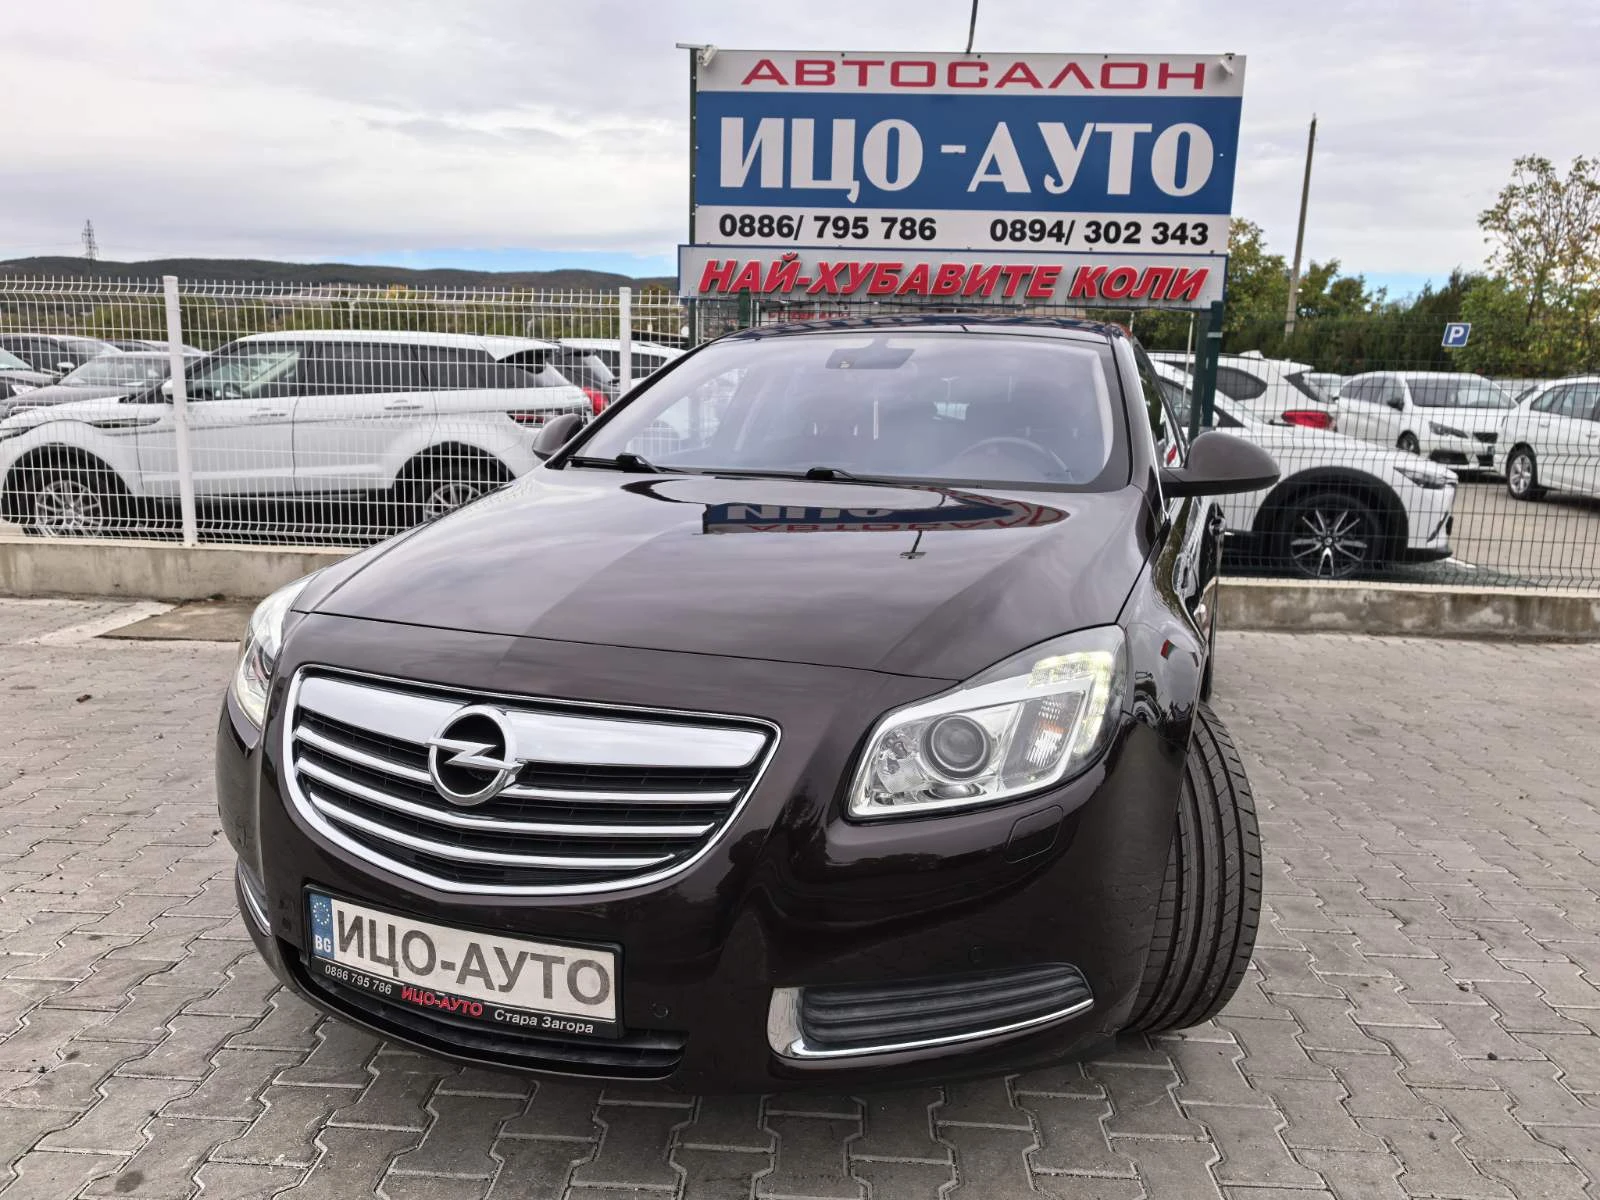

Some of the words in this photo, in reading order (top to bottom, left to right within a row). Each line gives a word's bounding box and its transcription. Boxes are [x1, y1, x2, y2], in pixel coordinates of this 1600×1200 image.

[741, 59, 1206, 90] АВТОСАЛОН
[718, 213, 805, 241] 0886/
[813, 215, 870, 240] 795
[880, 216, 938, 241] 786
[989, 219, 1076, 246] 0894/
[1083, 220, 1142, 245] 302
[1151, 222, 1210, 246] 343
[698, 251, 1063, 298] НАЙ-ХУБАВИТЕ
[1066, 265, 1209, 301] КОЛИ
[1448, 326, 1464, 343] P
[314, 934, 332, 953] BG
[337, 909, 611, 1006] ИЦО-АУТО
[324, 964, 349, 981] 0886
[351, 973, 370, 988] 795
[373, 980, 393, 996] 786
[401, 986, 483, 1017] ИЦО-АУТО
[494, 1009, 538, 1027] Стара
[541, 1016, 594, 1034] Загора
